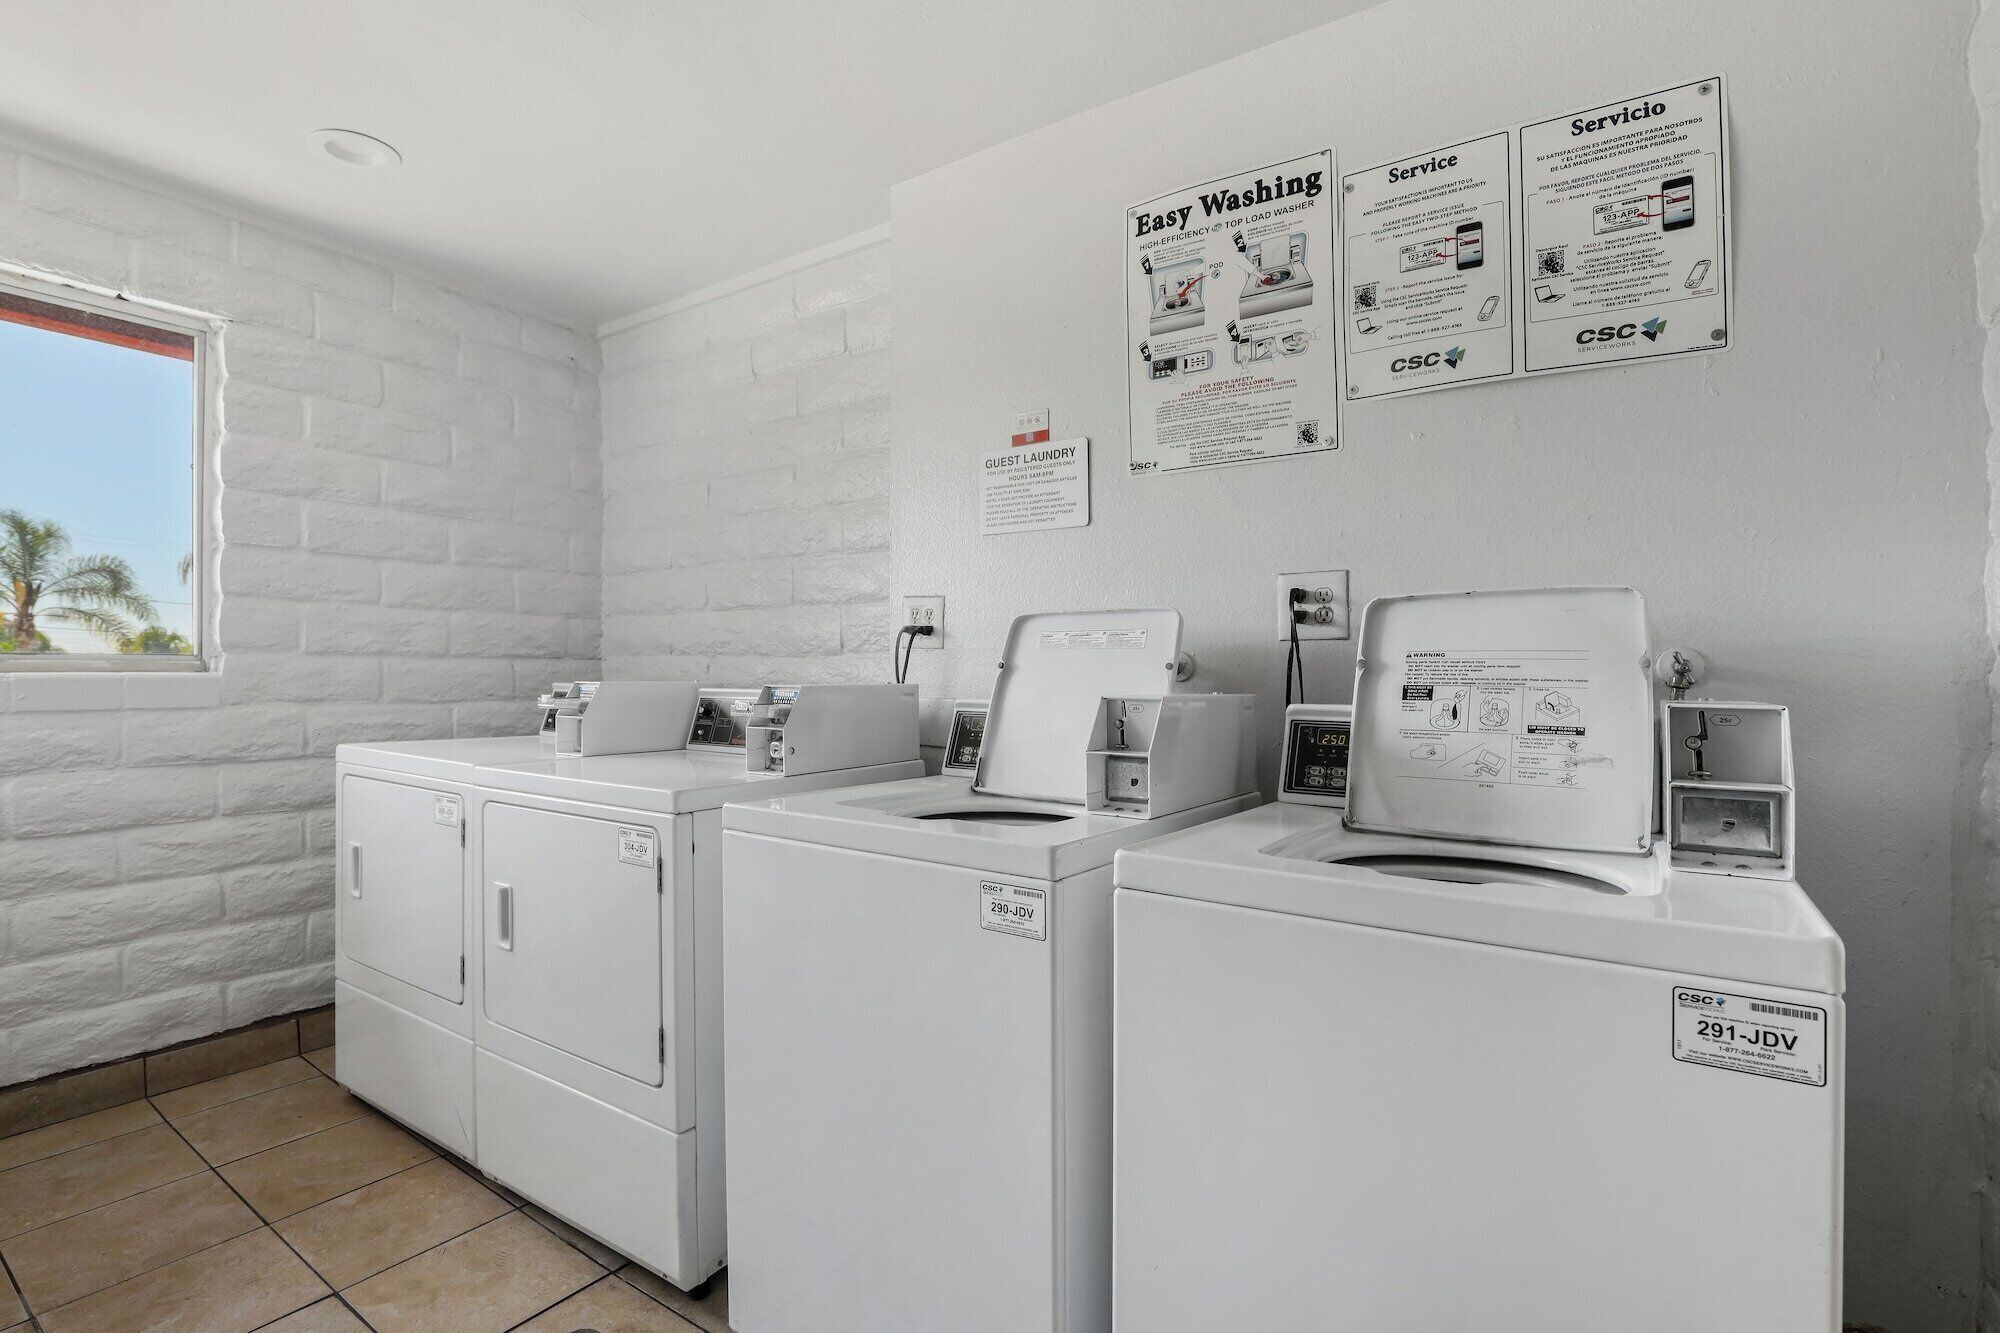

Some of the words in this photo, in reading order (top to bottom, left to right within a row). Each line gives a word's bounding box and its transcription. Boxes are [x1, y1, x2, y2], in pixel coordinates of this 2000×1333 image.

[1572, 102, 1666, 136] Servicio
[1600, 130, 1643, 146] IMPORTANTE
[1644, 126, 1662, 135] PARA
[1664, 116, 1702, 130] NOSOTROS
[1559, 162, 1571, 170] LAS
[1617, 143, 1648, 156] NUESTRA
[1649, 133, 1687, 148] PRIORIDAD
[1388, 155, 1458, 183] Service
[1555, 181, 1584, 193] SIGUIENDO
[1585, 178, 1598, 186] ESTE
[1650, 163, 1662, 171] DOS
[1663, 158, 1683, 168] PASOS
[1570, 173, 1594, 183] REPORTE
[1628, 158, 1658, 170] PROBLEMA
[1660, 154, 1671, 162] DEL
[1136, 206, 1192, 237] Easy
[1199, 171, 1322, 216] Washing
[1373, 203, 1397, 213] PROPERLY
[1398, 197, 1420, 207] WORKING
[1421, 190, 1446, 201] MACHINES
[1463, 180, 1486, 190] PRIORITY
[1375, 199, 1387, 207] YOUR
[1388, 190, 1422, 203] SATISFACTION
[1428, 181, 1457, 193] IMPORTANT
[1139, 225, 1210, 251] HIGH-EFFICIENCY
[1225, 217, 1243, 229] TOP
[1245, 210, 1271, 224] LOAD
[1273, 198, 1315, 217] WASHER
[1370, 224, 1399, 236] FOLLOWING
[1400, 221, 1410, 229] THE
[1412, 218, 1425, 226] EASY
[1454, 205, 1477, 216] METHOD
[1382, 218, 1400, 227] PLEASE
[1401, 213, 1421, 222] REPORT
[1427, 207, 1445, 216] SERVICE
[1446, 202, 1464, 211] ISSUE
[1576, 322, 1636, 345] CSC
[1577, 340, 1635, 353] SERVICEWORKS
[1390, 351, 1440, 372] CSC
[985, 454, 1020, 469] GUEST
[1023, 446, 1075, 463] LAUNDRY
[982, 884, 998, 892] CSC
[991, 901, 1034, 919] 290-JDV
[1678, 992, 1713, 1005] CSC
[1697, 1019, 1798, 1051] 291-JDV
